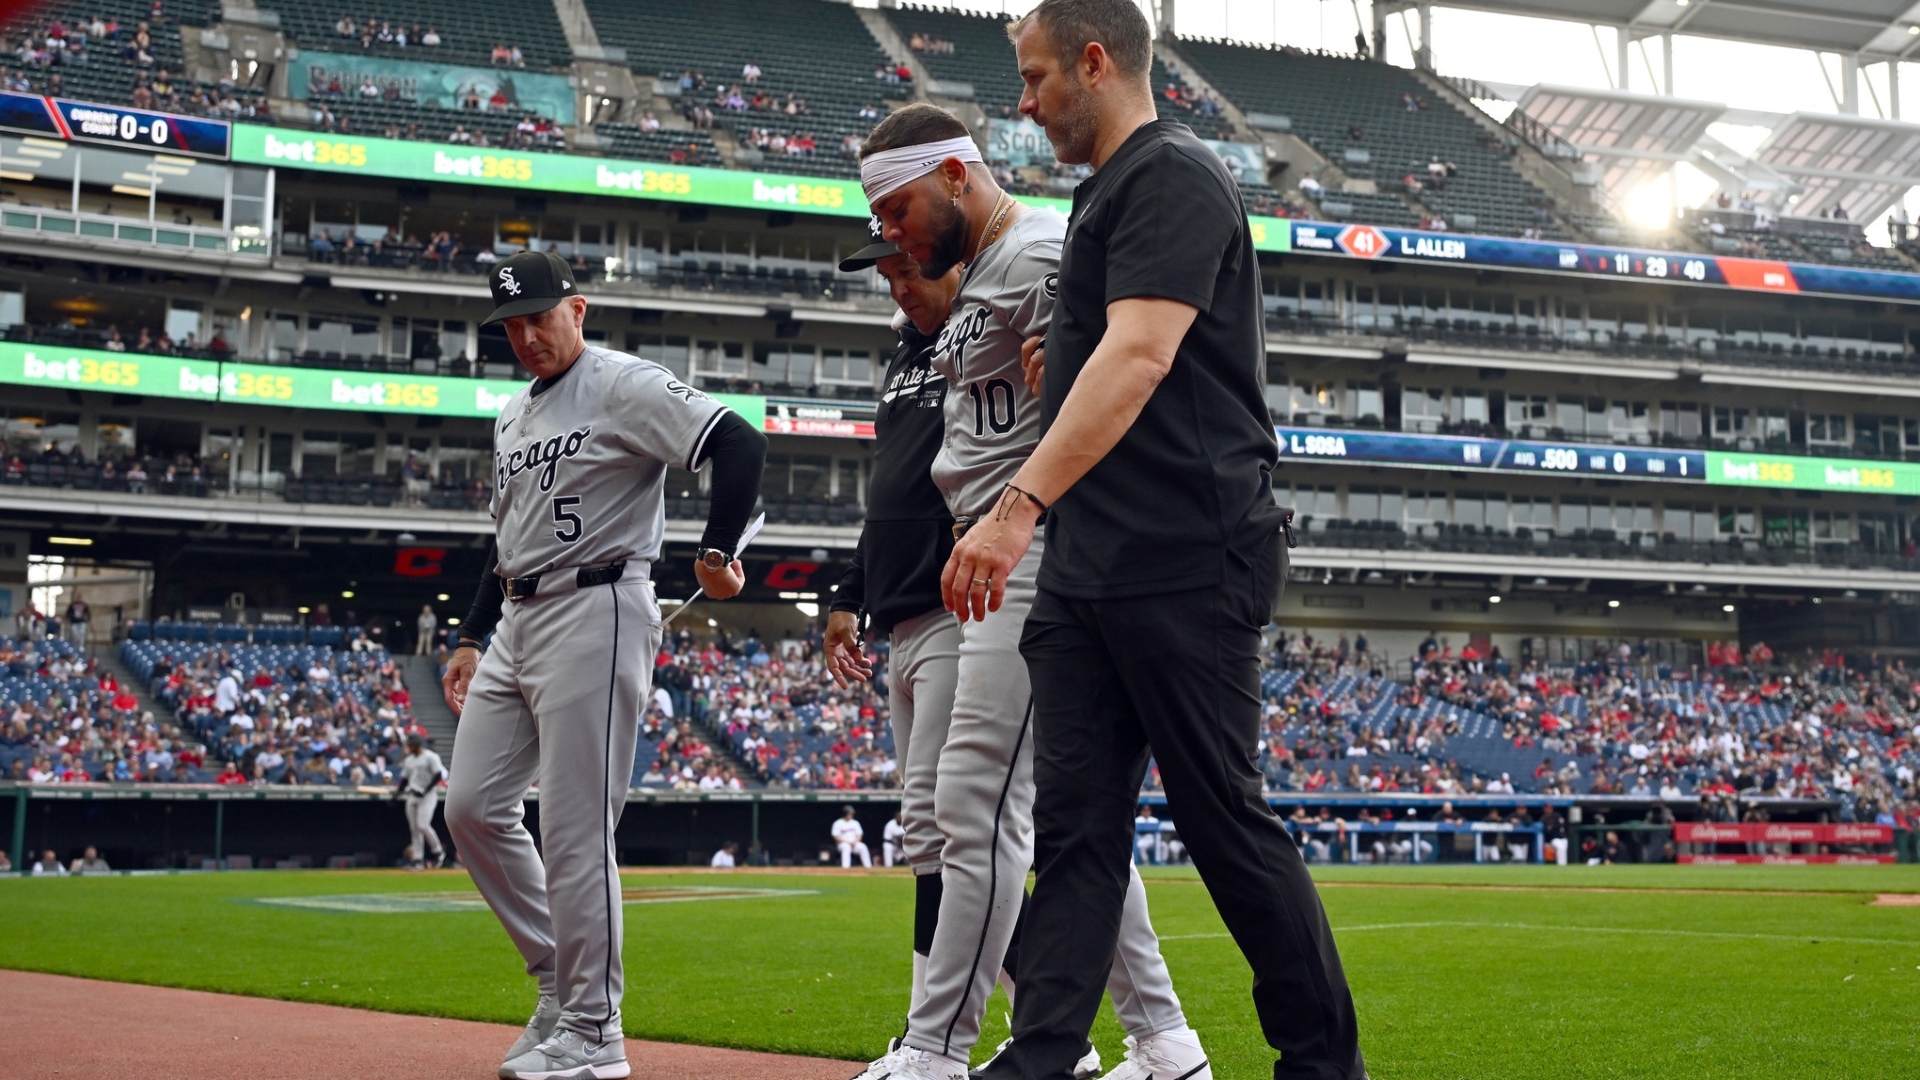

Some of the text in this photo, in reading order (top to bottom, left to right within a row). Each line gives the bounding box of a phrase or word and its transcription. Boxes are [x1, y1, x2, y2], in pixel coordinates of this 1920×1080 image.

[70, 107, 119, 125] CURRENT
[120, 115, 169, 145] 0-0
[264, 133, 367, 166] bet365
[434, 150, 532, 180] bet365
[596, 164, 691, 194] bet365
[753, 178, 843, 207] bet365
[1353, 231, 1375, 254] 41
[499, 266, 522, 297] Sox
[1615, 253, 1630, 274] 11
[1646, 256, 1668, 277] 29
[1683, 260, 1706, 281] 40
[23, 352, 140, 387] bet365
[179, 366, 293, 399] bet365
[331, 378, 439, 408] bet365
[969, 377, 1018, 438] 10
[796, 407, 843, 421] CHICAGO
[496, 426, 592, 493] hicago
[1540, 448, 1578, 470] .500
[1612, 452, 1627, 473] 0
[1678, 456, 1688, 476] 1
[1722, 458, 1795, 483] bet365
[1824, 464, 1895, 488] bet365
[552, 495, 583, 545] 5
